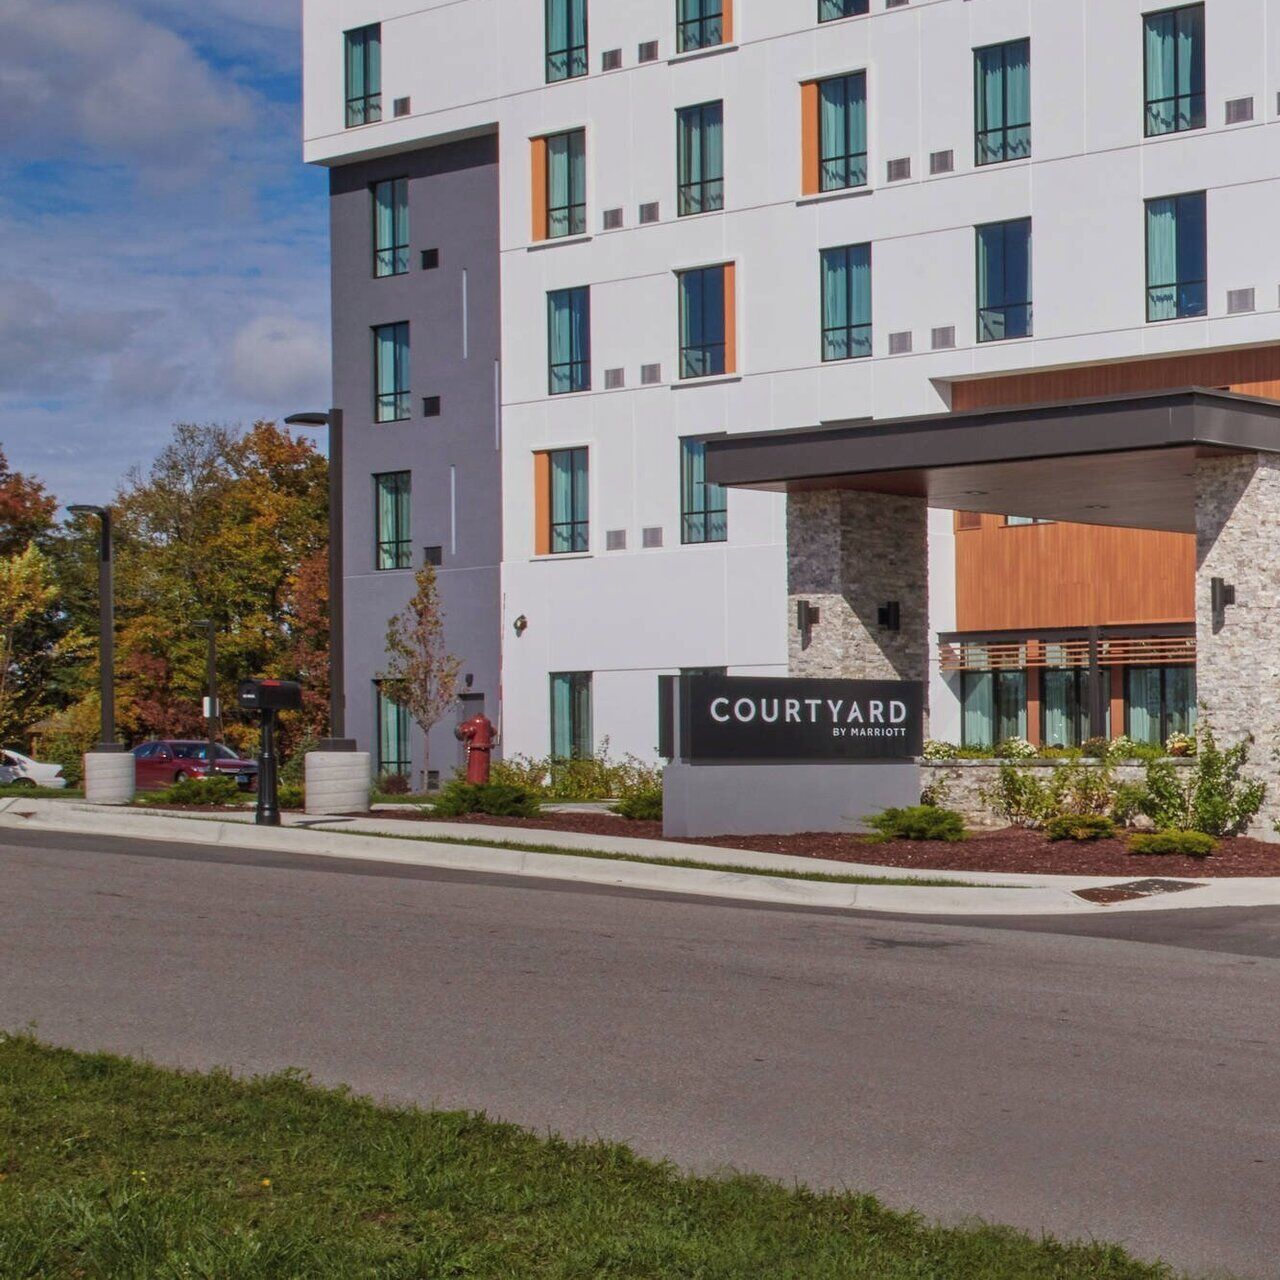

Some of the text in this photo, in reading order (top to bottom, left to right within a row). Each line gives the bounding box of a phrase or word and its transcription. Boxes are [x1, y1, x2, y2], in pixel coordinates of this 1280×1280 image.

[710, 697, 907, 723] COURTYARD
[832, 727, 906, 737] BY MARRIOTT
